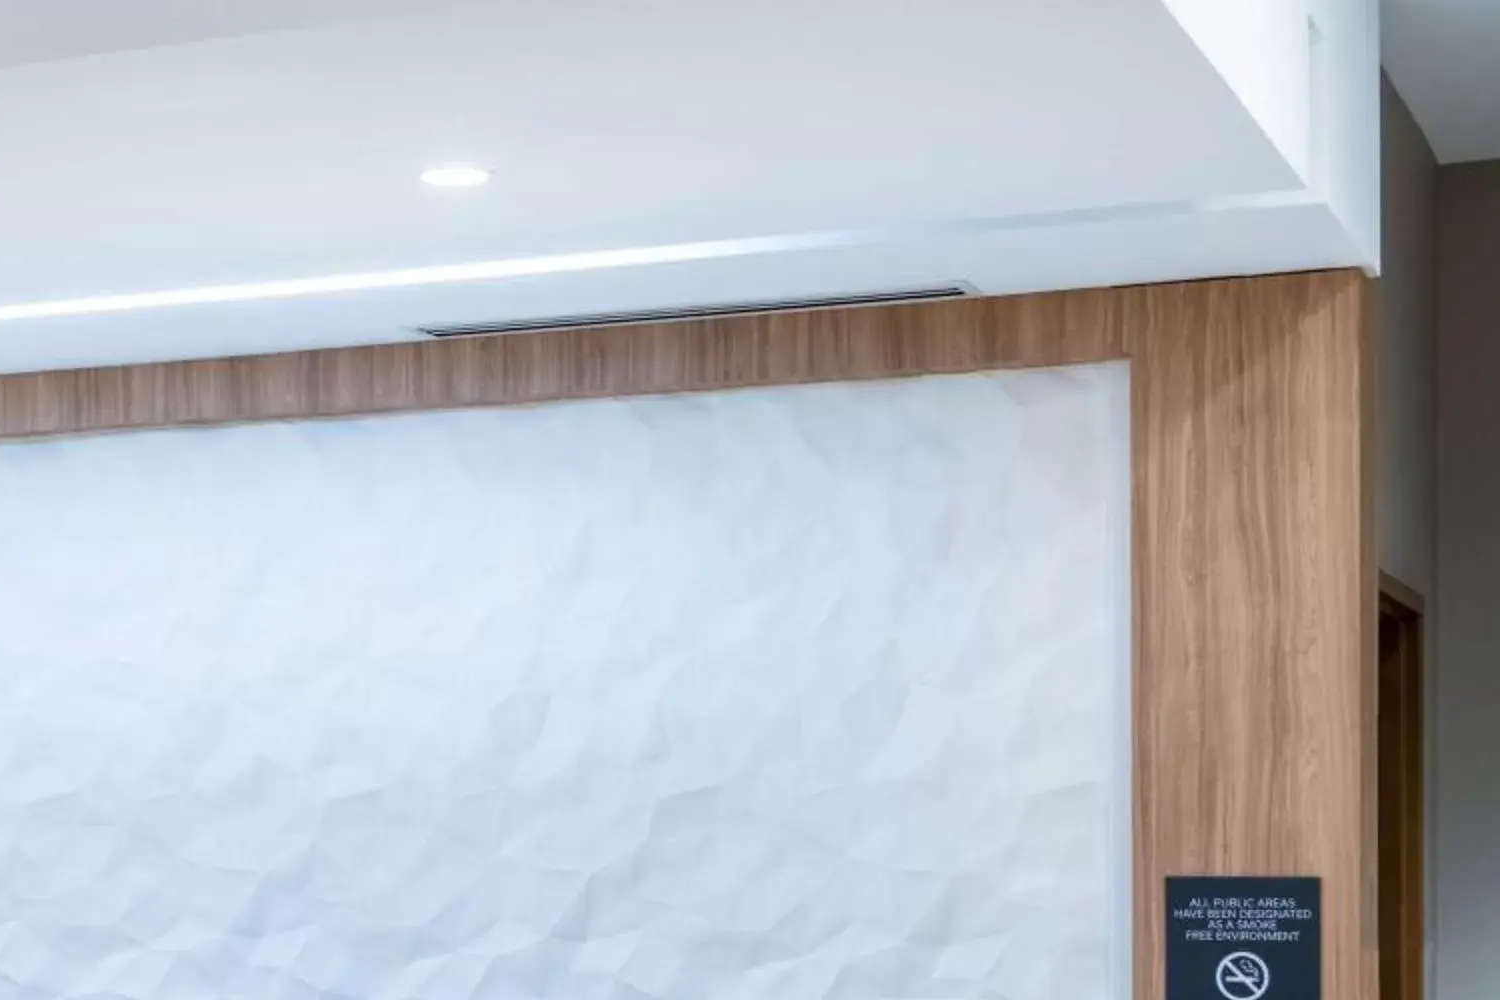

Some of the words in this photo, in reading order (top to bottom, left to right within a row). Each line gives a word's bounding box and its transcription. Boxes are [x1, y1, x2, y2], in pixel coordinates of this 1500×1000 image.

[1189, 897, 1209, 908] ALL
[1213, 897, 1254, 908] PUBLIC
[1257, 898, 1297, 908] AREAS
[1174, 909, 1205, 919] HAVE
[1207, 909, 1237, 919] BEEN
[1239, 909, 1313, 919] DESIGNATED
[1207, 920, 1224, 930] AS
[1237, 920, 1278, 931] SMOKE
[1185, 930, 1214, 941] FREE
[1215, 931, 1300, 941] ENVIRONMENT
